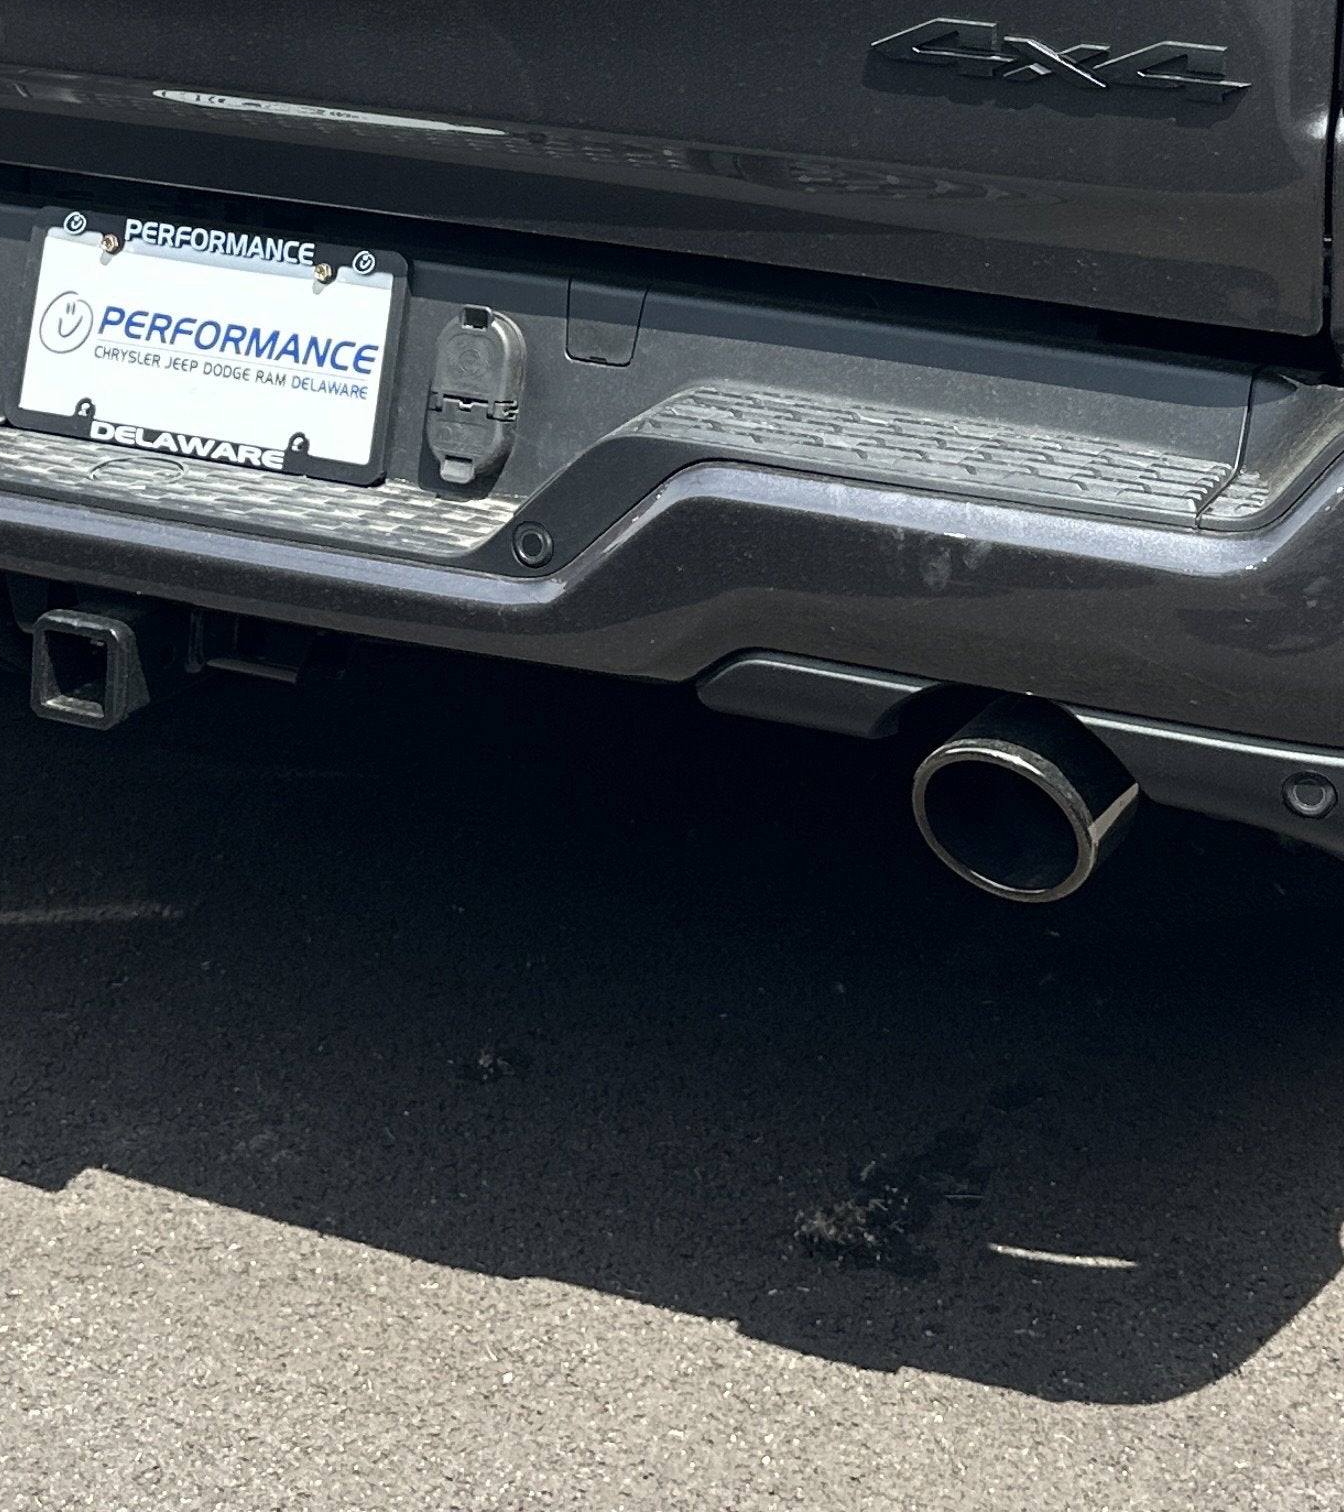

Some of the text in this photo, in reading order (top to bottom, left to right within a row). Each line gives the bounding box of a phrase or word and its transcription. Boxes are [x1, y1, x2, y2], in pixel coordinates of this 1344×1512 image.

[124, 218, 315, 265] PERFORMANCE
[98, 306, 379, 374] PERFORMANCE
[94, 345, 369, 400] CHRYSLER JEEP DODGE RAM DELAWARE
[90, 420, 285, 470] DELAWARE
